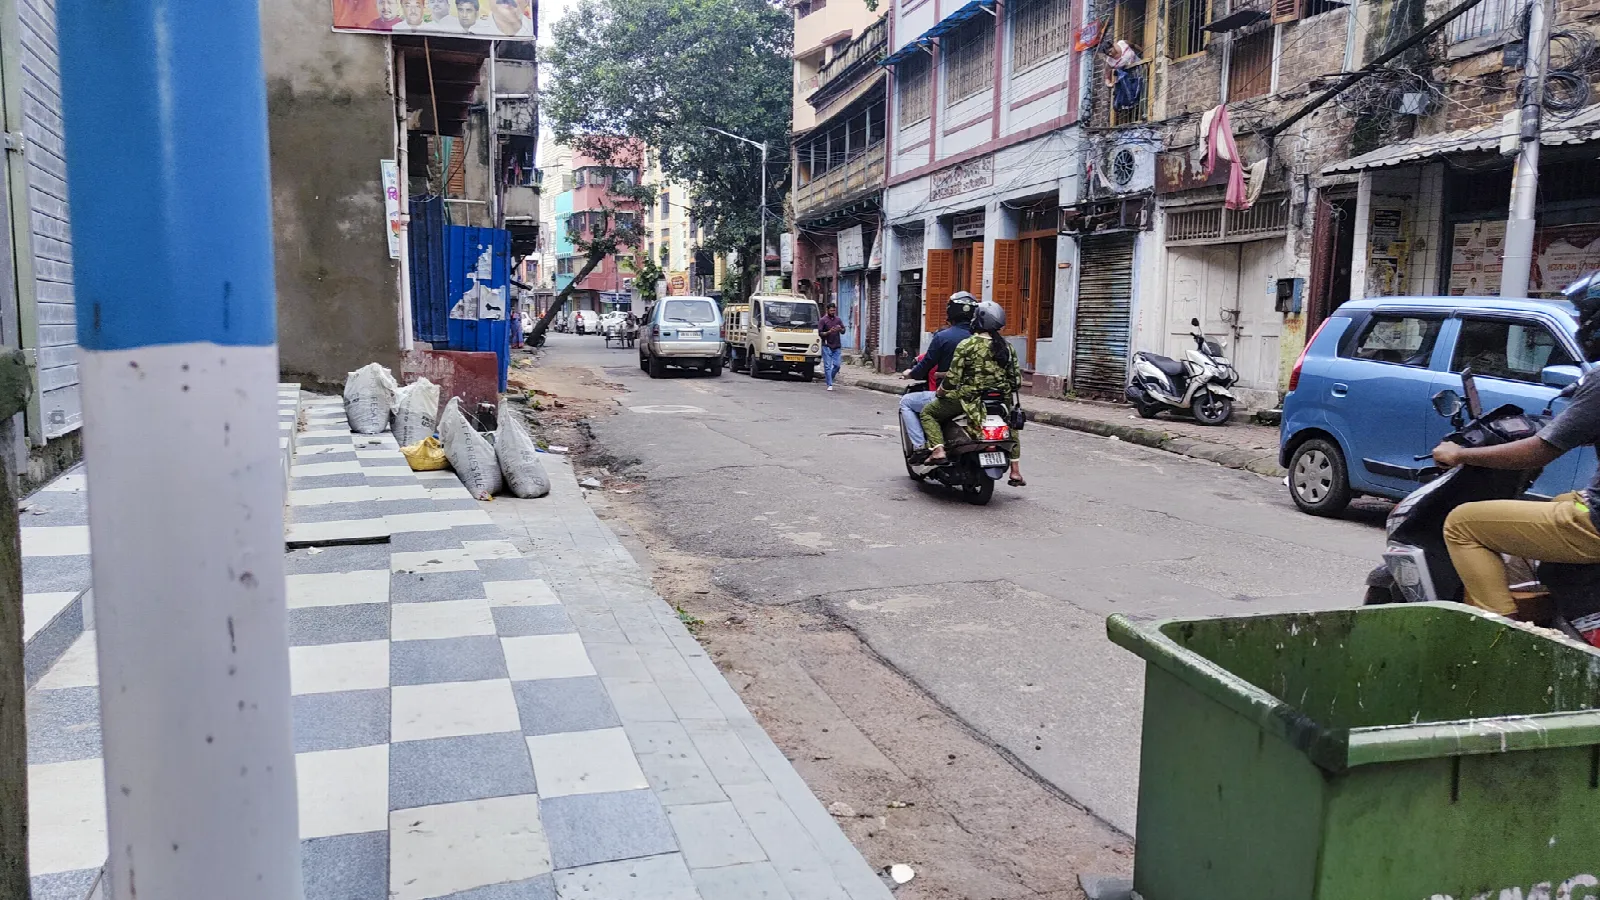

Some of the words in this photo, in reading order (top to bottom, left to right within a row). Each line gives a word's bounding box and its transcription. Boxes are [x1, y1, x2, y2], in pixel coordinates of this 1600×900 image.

[370, 396, 379, 427] RESALE
[464, 432, 474, 454] FOR
[468, 454, 485, 489] RESALE
